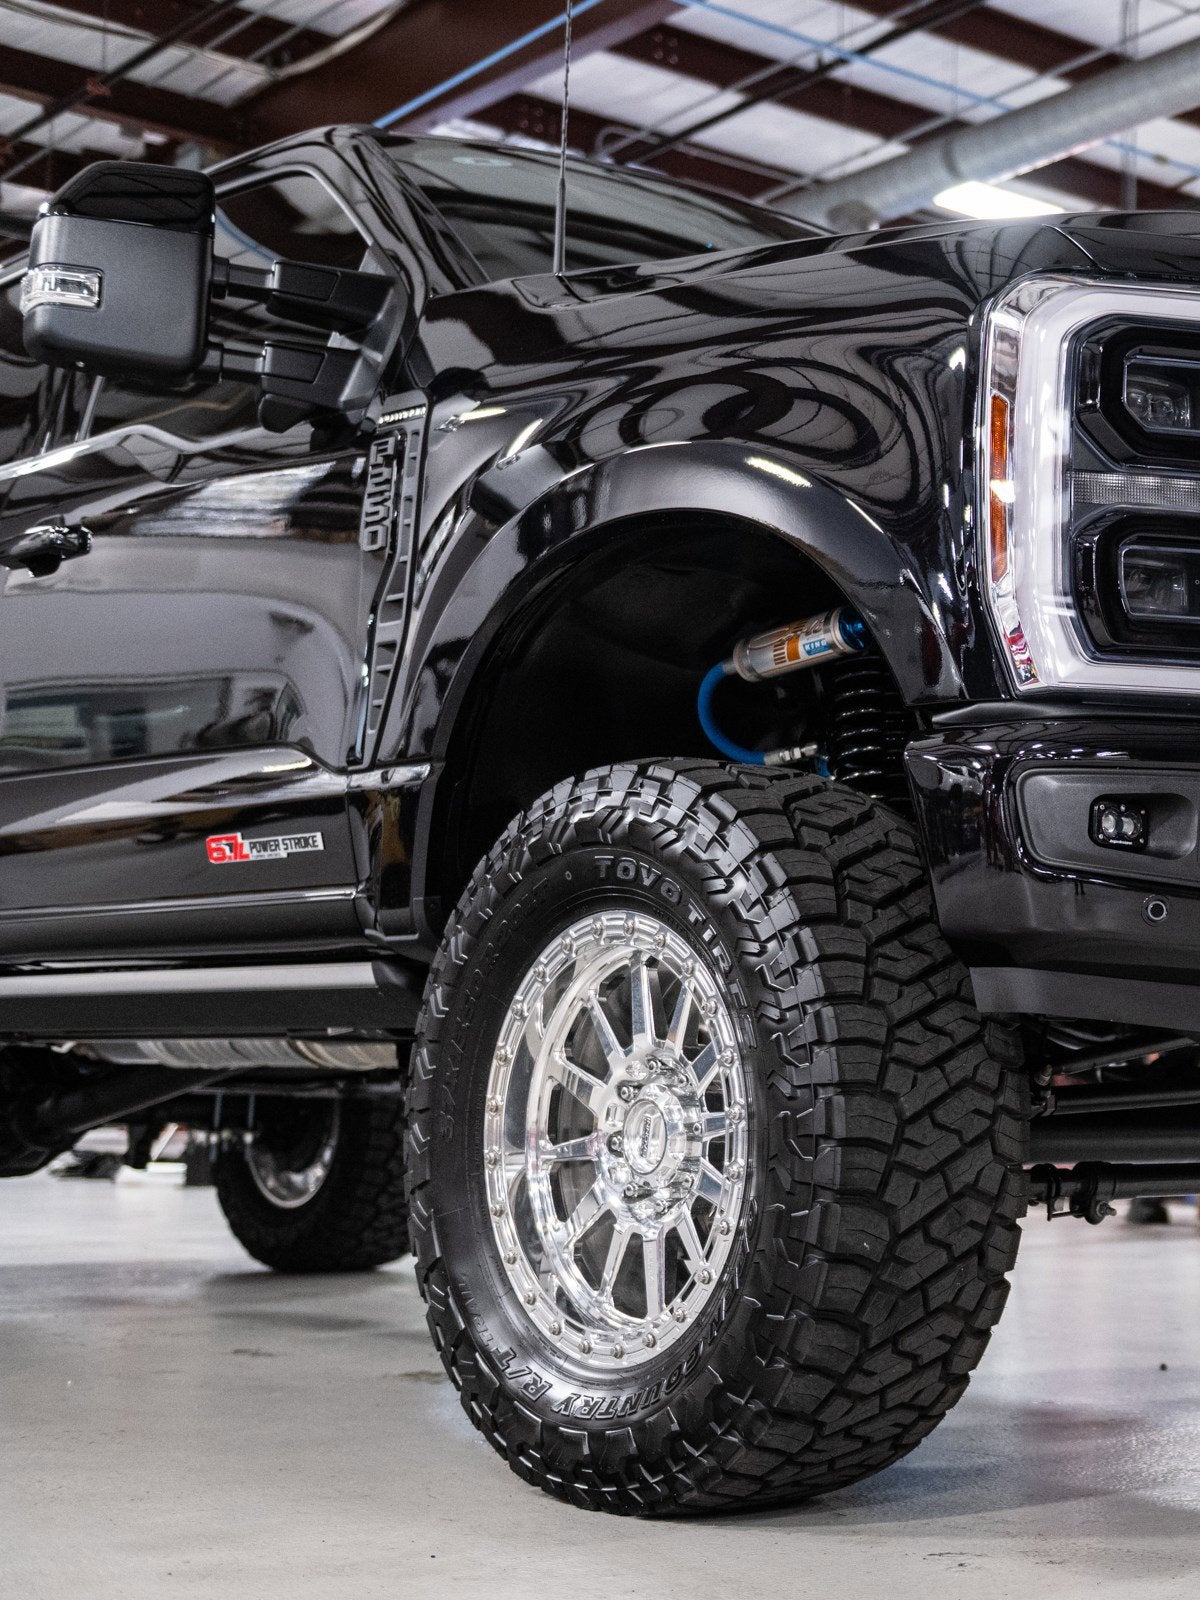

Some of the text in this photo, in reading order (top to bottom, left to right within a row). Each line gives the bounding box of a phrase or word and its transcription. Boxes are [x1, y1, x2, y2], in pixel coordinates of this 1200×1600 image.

[249, 839, 281, 853] POWER
[281, 835, 319, 851] STROKE
[594, 855, 683, 904] TOYO
[499, 1347, 554, 1402] R/T
[552, 1340, 704, 1421] COUNTRY
